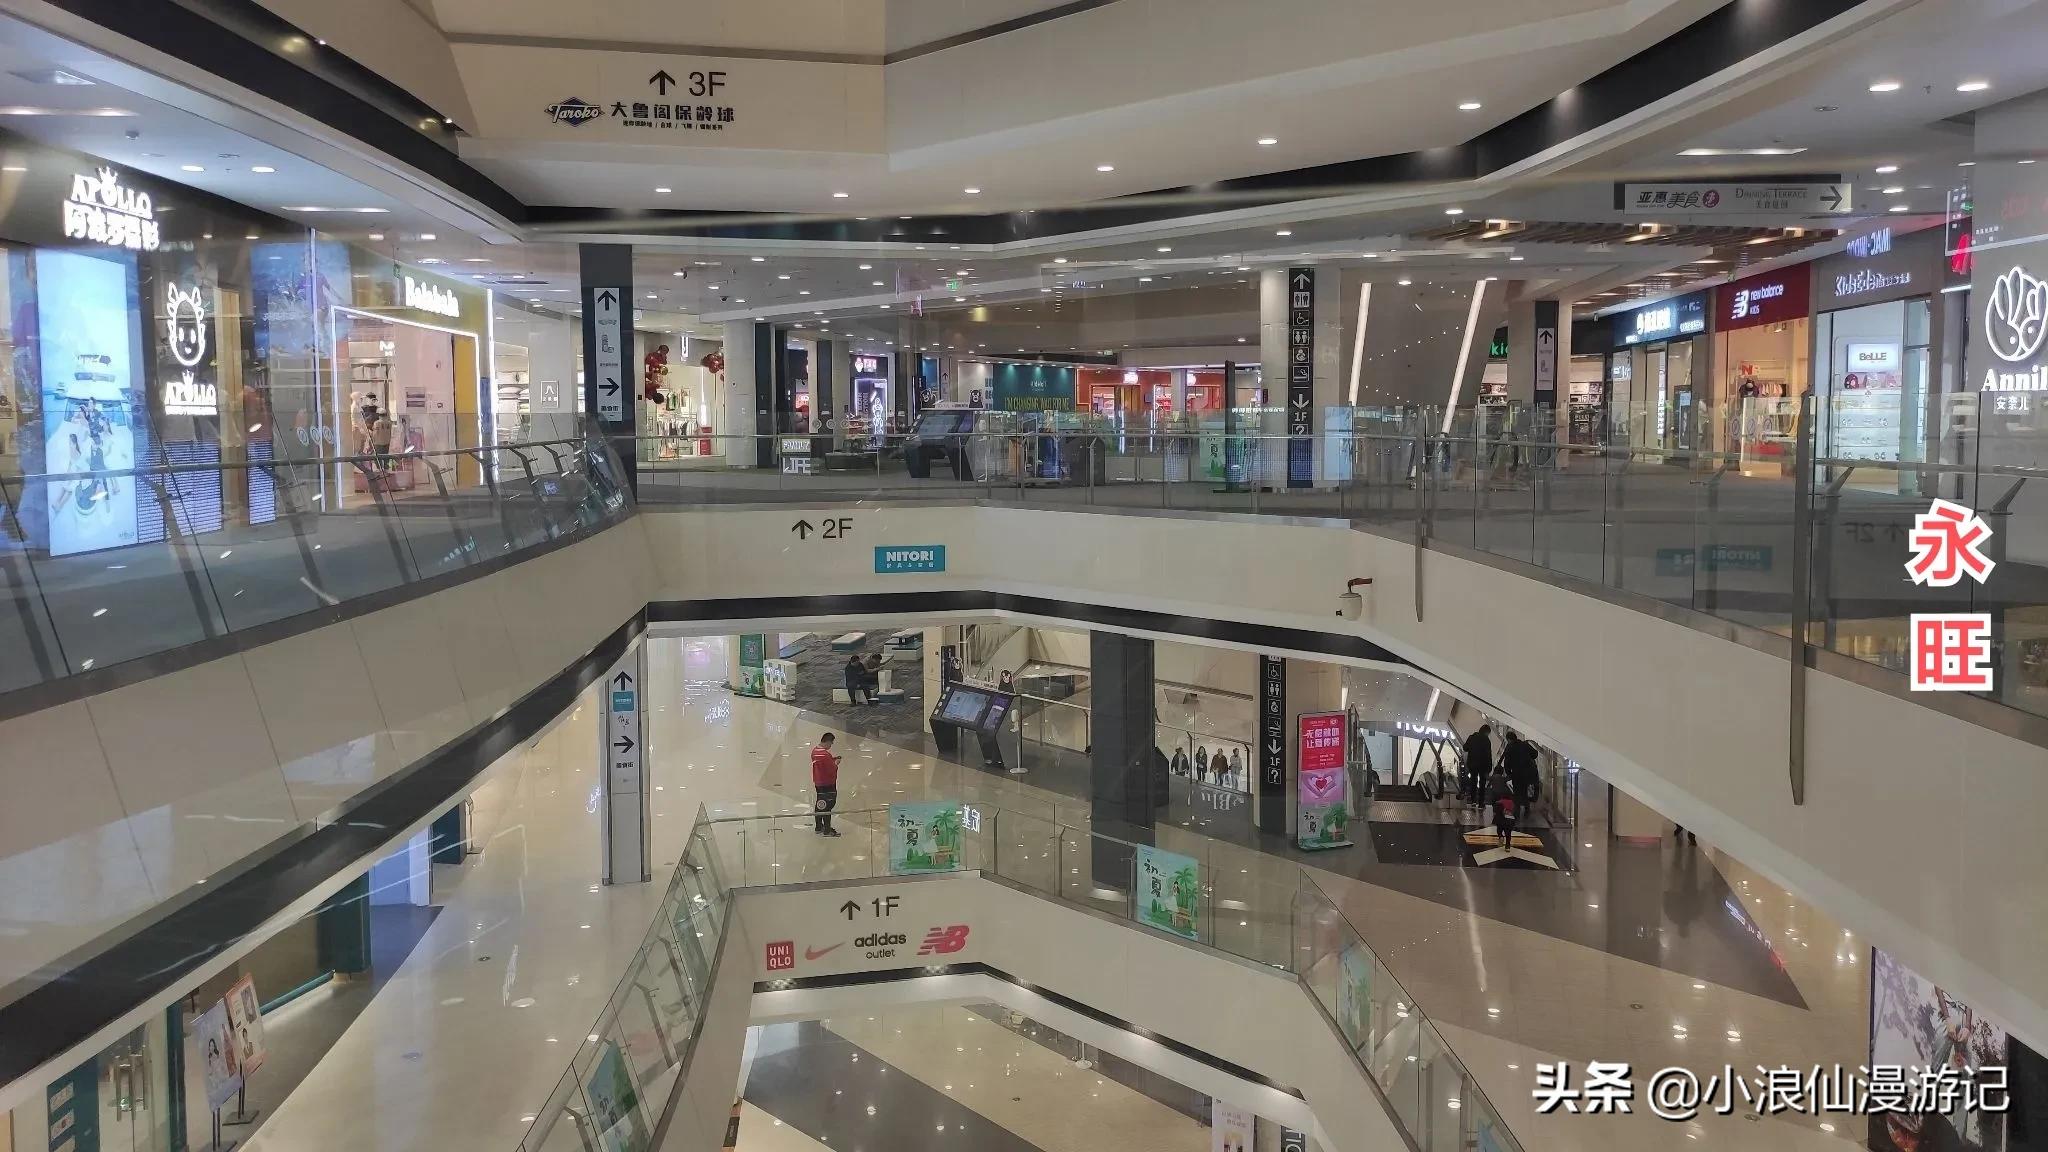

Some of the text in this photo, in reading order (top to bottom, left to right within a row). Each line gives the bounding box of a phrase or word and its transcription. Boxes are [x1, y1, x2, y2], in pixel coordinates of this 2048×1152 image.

[689, 71, 727, 97] 3F
[548, 104, 601, 123] Taroko
[610, 101, 735, 123] 大鲁阁保龄球
[70, 173, 153, 219] APOLLO
[1294, 412, 1307, 422] 1F
[822, 518, 854, 539] 2F
[886, 550, 934, 562] NITORI
[1269, 756, 1281, 767] 1F
[871, 895, 900, 918] 1F
[854, 932, 907, 948] adidas
[769, 946, 789, 956] UNI
[865, 949, 896, 960] outlet
[770, 956, 791, 969] QLO
